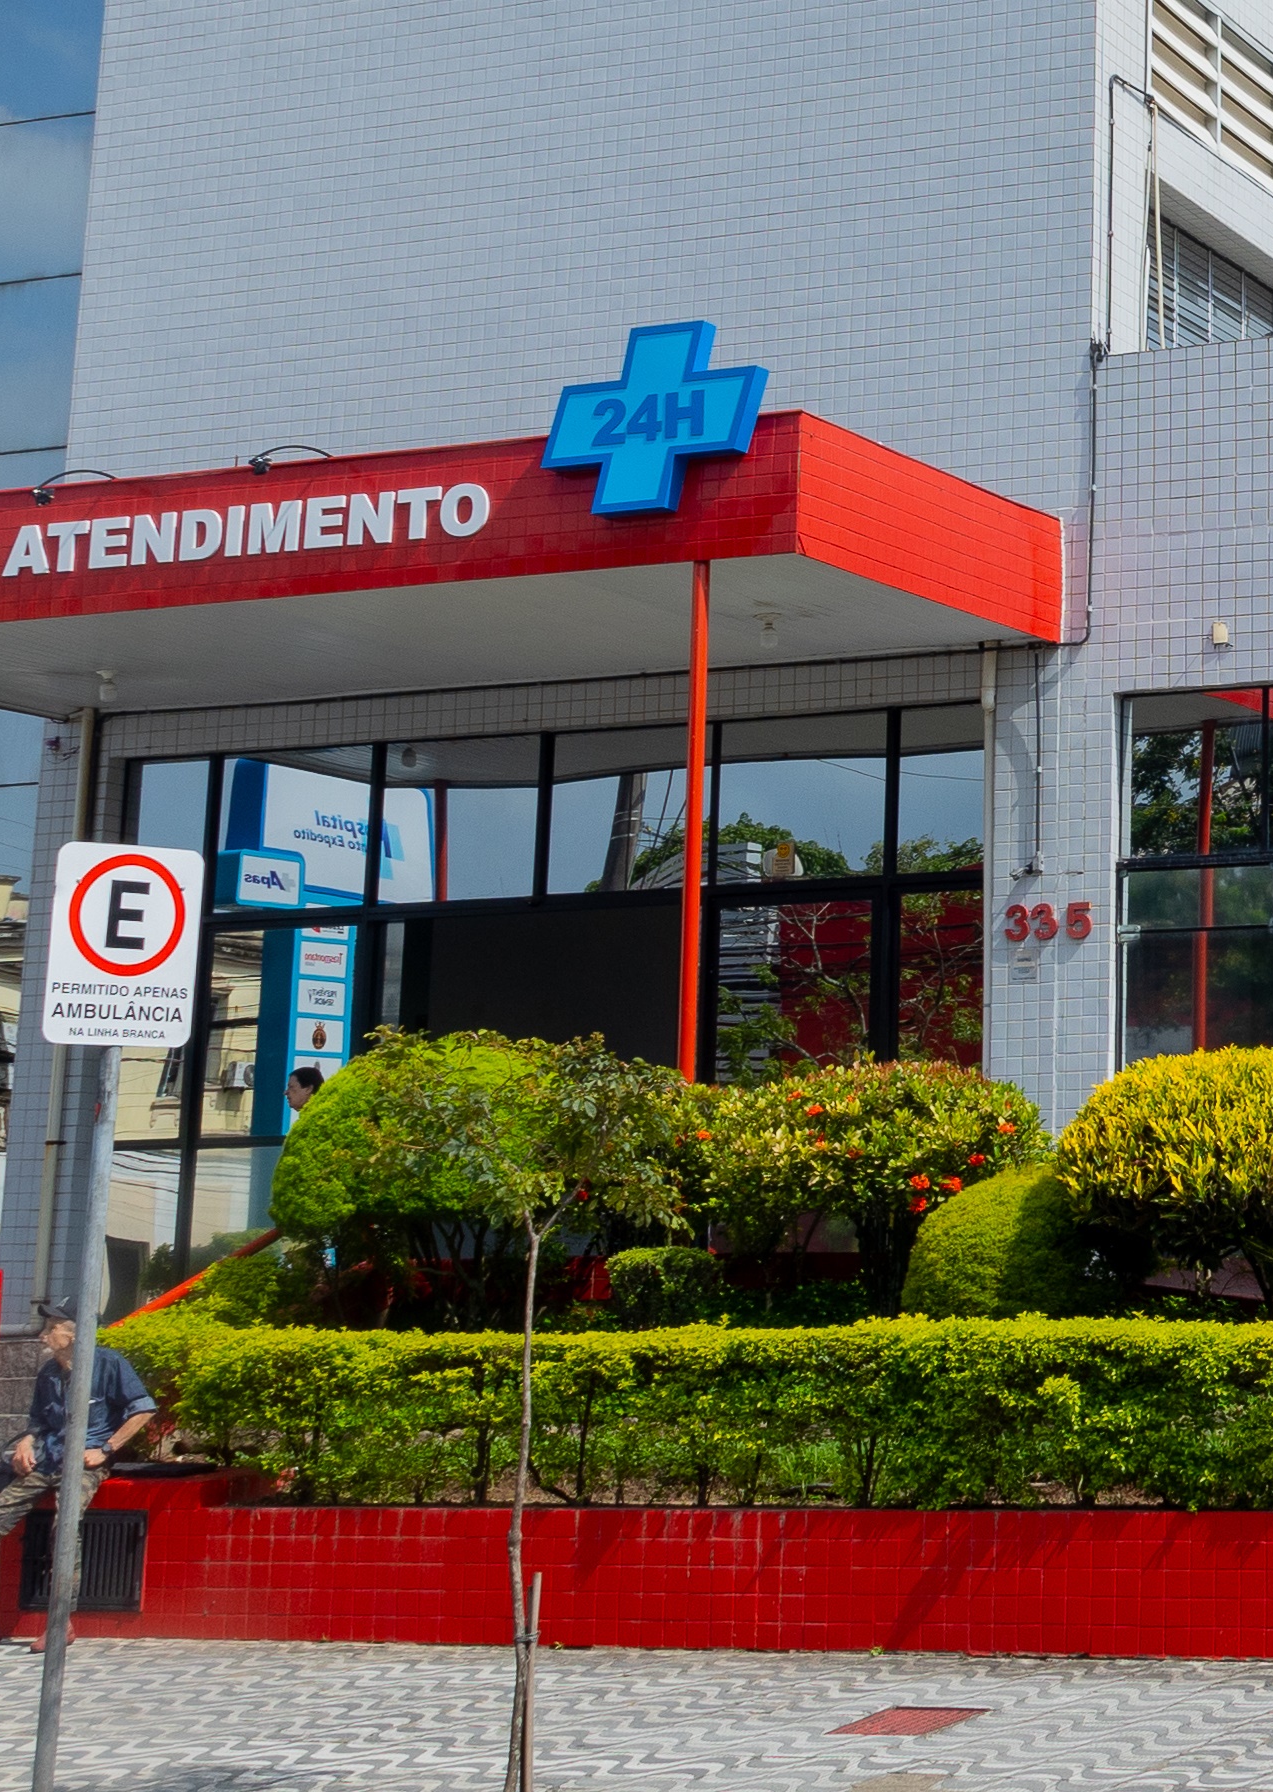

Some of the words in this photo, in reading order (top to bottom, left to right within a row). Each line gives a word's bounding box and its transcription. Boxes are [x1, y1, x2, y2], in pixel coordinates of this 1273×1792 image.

[591, 390, 705, 448] 24H
[1, 482, 491, 578] ATENDIMENTO
[104, 880, 151, 950] E
[1004, 902, 1093, 942] 335
[51, 982, 129, 997] PERMITIDO
[133, 986, 189, 1000] APENAS
[51, 1001, 183, 1023] AMBULÂNCIA
[68, 1027, 84, 1037] NA
[87, 1028, 120, 1038] LINHA
[122, 1029, 166, 1040] BRANCA
